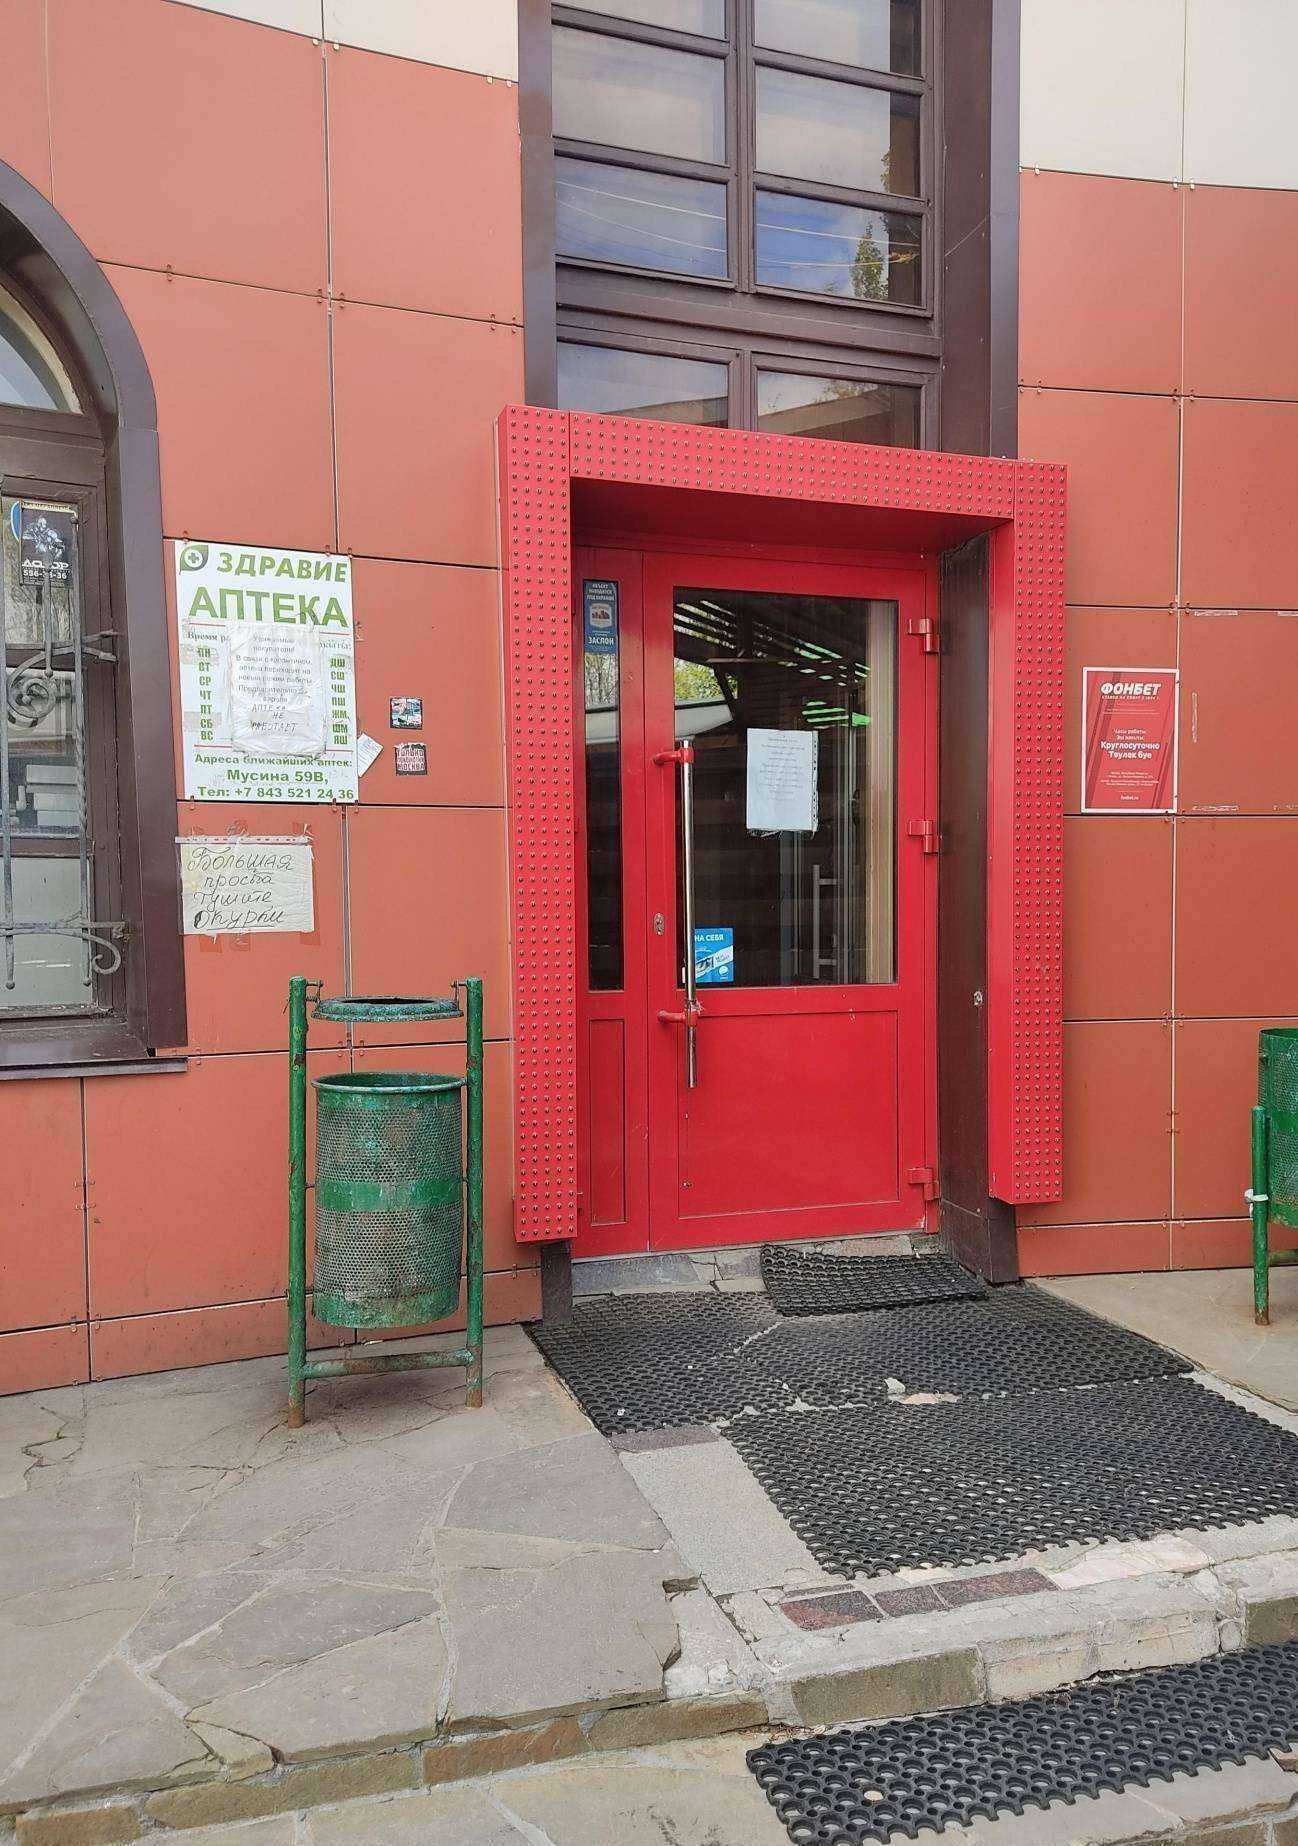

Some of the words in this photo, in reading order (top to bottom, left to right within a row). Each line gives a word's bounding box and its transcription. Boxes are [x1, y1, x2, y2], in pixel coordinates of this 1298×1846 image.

[216, 552, 348, 583] ЗДРАВИЕ
[188, 586, 349, 628] АПТЕКА
[588, 636, 614, 646] ЗАСЛОН
[197, 647, 211, 658] ПН
[198, 661, 210, 672] ВТ
[199, 675, 212, 687] СР
[330, 671, 345, 681] СШ
[331, 683, 346, 693] ЧШ
[1100, 682, 1162, 696] ФОНБЕТ
[200, 690, 212, 700] ЧТ
[331, 696, 346, 706] ПШ
[200, 704, 212, 715] ПТ
[200, 718, 213, 729] СБ
[200, 730, 214, 741] ВС
[1100, 741, 1160, 753] Круглосуточно
[194, 753, 240, 765] Адреса
[243, 754, 314, 767] ближайших
[227, 769, 290, 783] Мусина
[294, 771, 329, 785] 59В,
[197, 786, 230, 797] Тел:
[234, 787, 252, 797] +7
[256, 787, 283, 798] 843
[287, 788, 313, 798] 521
[316, 788, 334, 798] 24
[338, 789, 354, 799] 36
[705, 934, 724, 942] СЕБЯ
